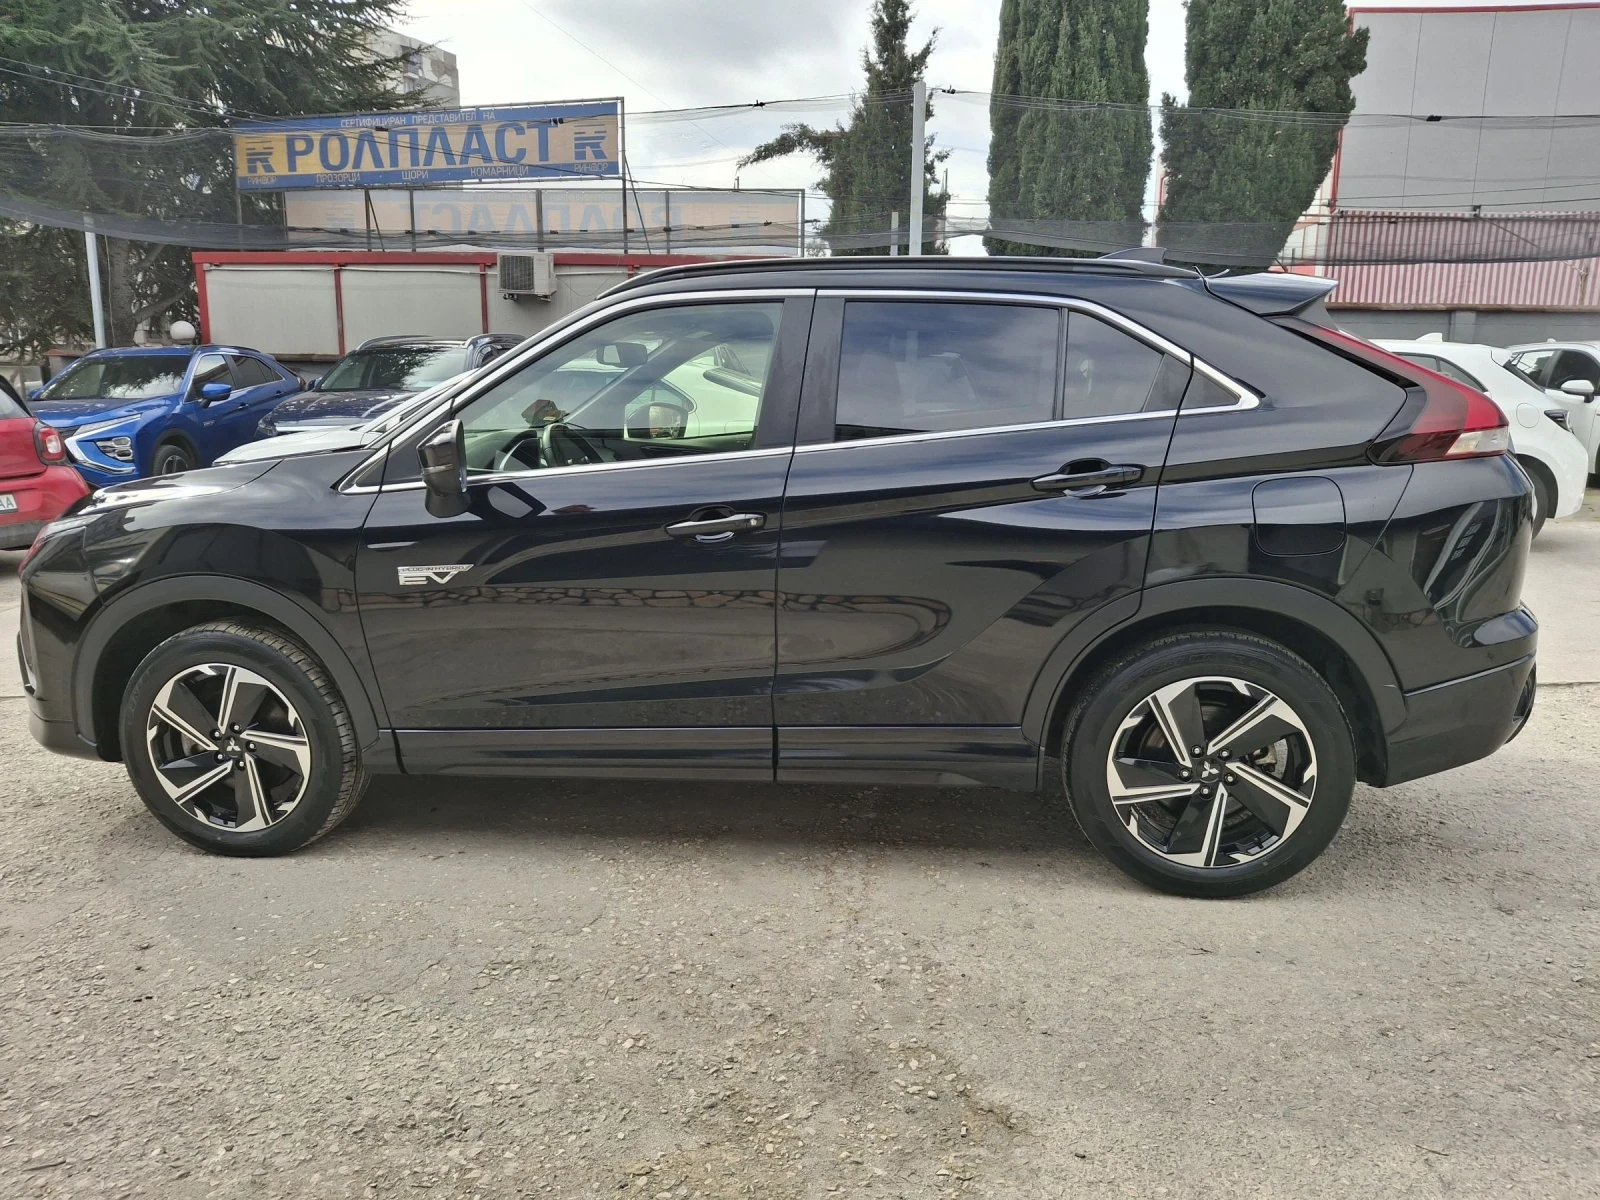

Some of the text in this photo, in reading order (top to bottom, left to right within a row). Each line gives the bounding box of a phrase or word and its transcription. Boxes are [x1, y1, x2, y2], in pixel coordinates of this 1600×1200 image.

[340, 111, 496, 128] СЕРТИФИЦИРАН ПРЕДСТАВИТЕЛ НА
[286, 122, 559, 173] РОЛПЛАСТ
[316, 172, 361, 183] ПРОЗОРЦИ
[401, 169, 429, 180] ЩОРИ
[470, 165, 529, 177] КОМАРНИЦИ
[398, 571, 460, 585] EV
